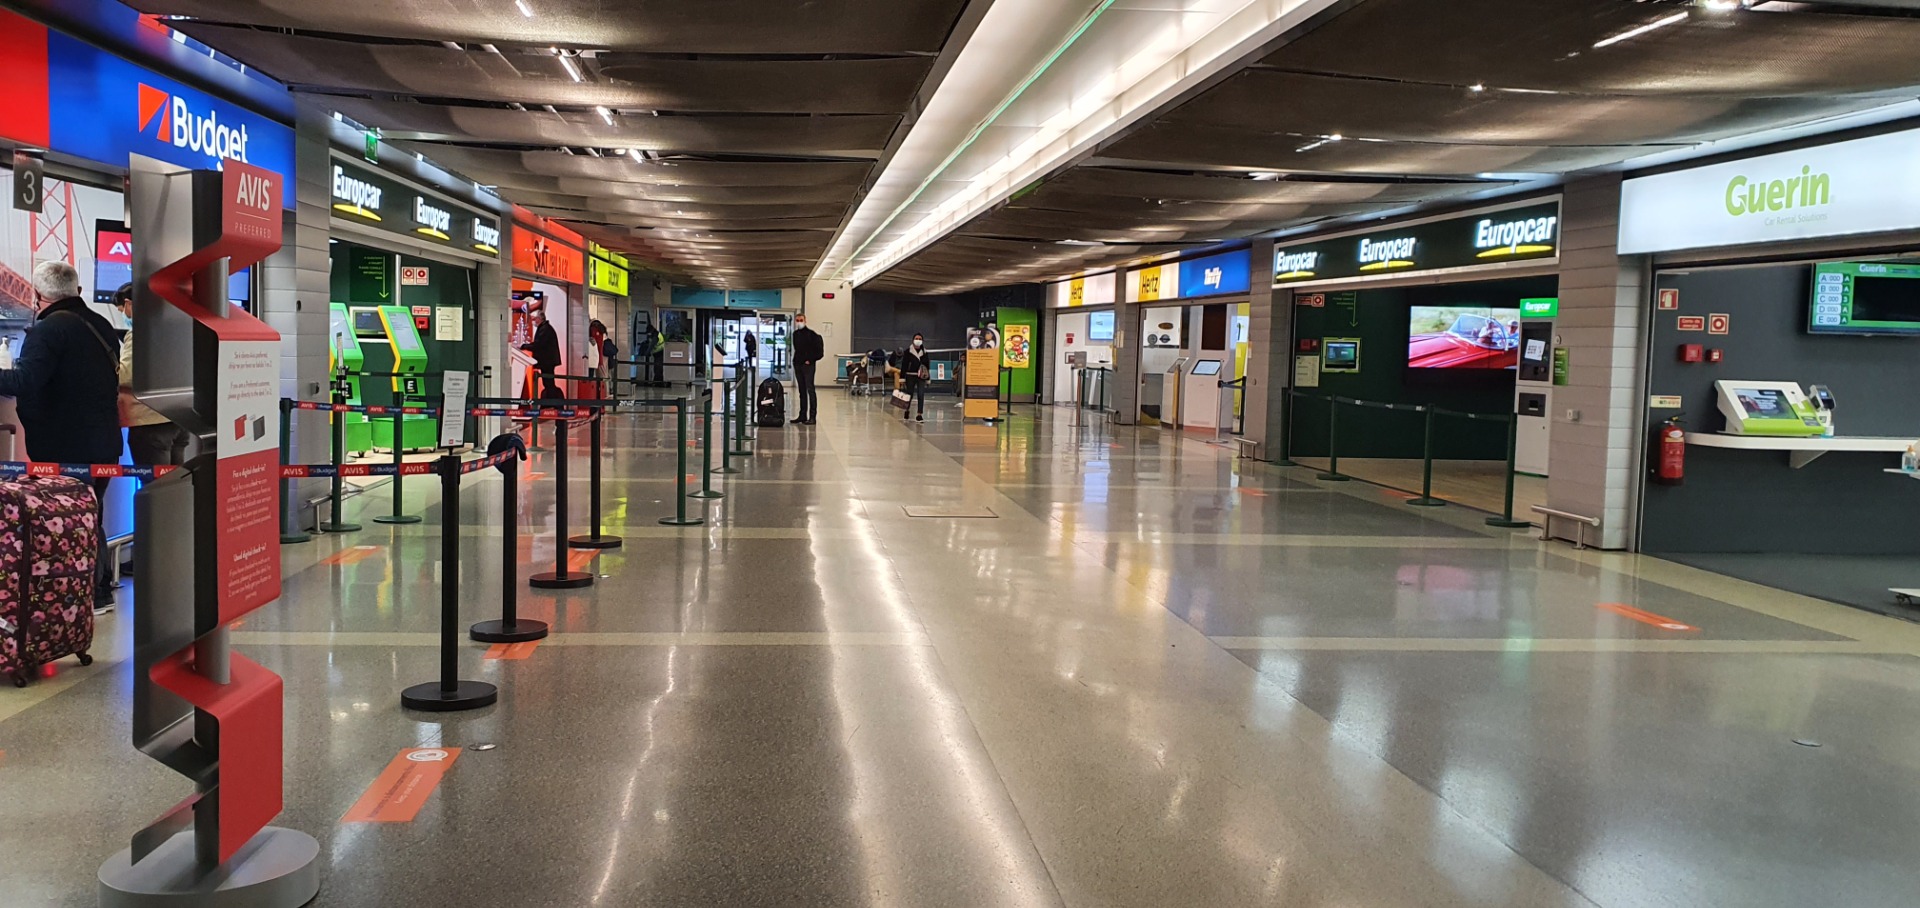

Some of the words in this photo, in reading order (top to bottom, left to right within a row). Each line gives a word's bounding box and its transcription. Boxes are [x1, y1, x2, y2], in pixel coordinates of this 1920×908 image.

[172, 95, 249, 172] Budget
[22, 170, 36, 205] 3
[236, 172, 270, 211] AVIS
[333, 165, 382, 215] Europcar
[1725, 164, 1830, 216] Guerin
[234, 222, 272, 239] PREFERRED
[416, 196, 451, 236] Europcar
[1764, 217, 1776, 226] Car
[1777, 216, 1796, 225] Rental
[1798, 213, 1828, 223] Solutions
[474, 218, 499, 248] Europcar
[1476, 216, 1557, 254] Europcar
[1276, 251, 1317, 277] Europcar
[1360, 237, 1416, 267] Europcar
[1859, 264, 1887, 273] Guerin
[1142, 274, 1159, 294] Hertz
[407, 380, 414, 390] E
[68, 466, 89, 474] Budget
[97, 467, 118, 475] AVIS
[283, 468, 303, 476] AVIS
[316, 466, 336, 474] Budget
[344, 467, 364, 475] AVIS
[405, 465, 424, 473] AVIS
